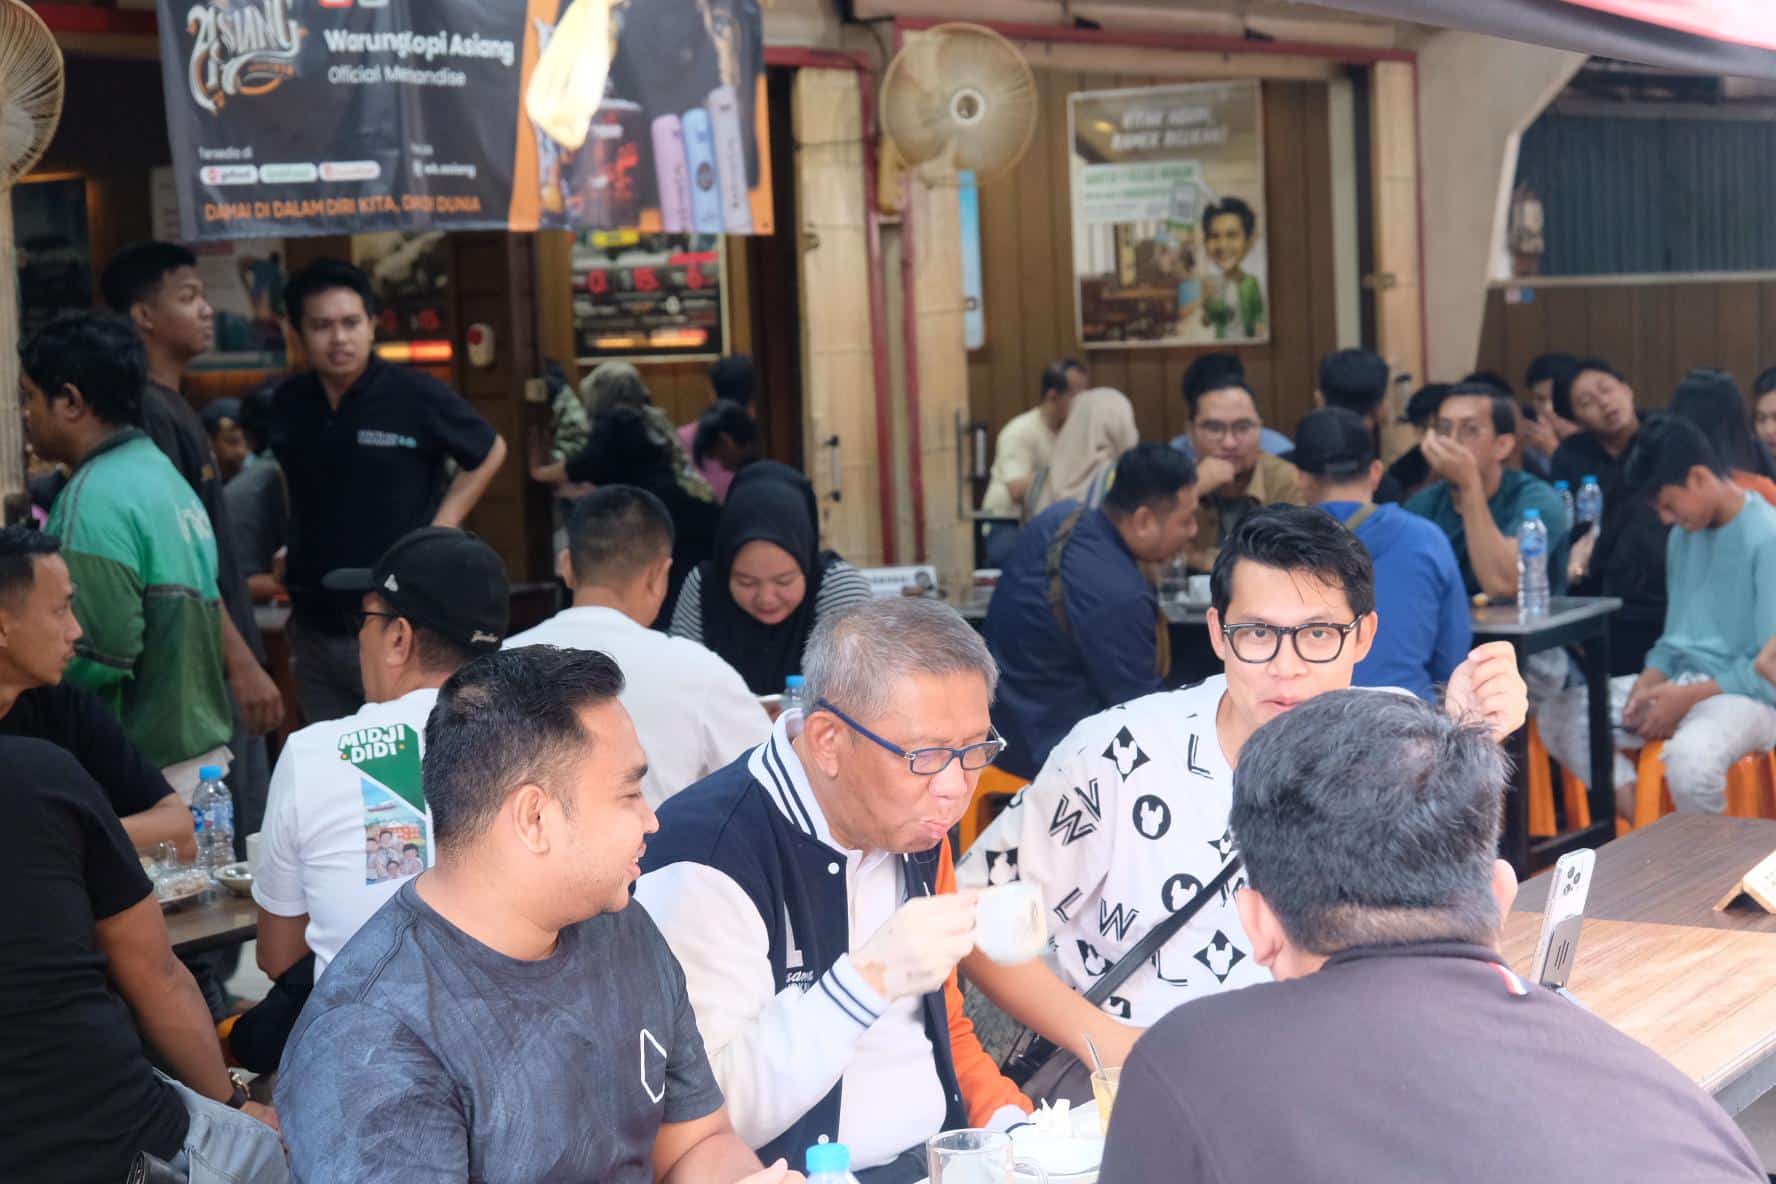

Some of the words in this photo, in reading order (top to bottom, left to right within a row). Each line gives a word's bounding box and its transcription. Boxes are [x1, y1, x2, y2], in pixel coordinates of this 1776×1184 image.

[449, 32, 515, 67] Asiang
[327, 64, 382, 85] Official
[204, 201, 252, 221] DAMAI
[254, 201, 270, 219] DI
[272, 199, 325, 219] DALAM
[338, 723, 406, 750] MIDJI
[351, 742, 398, 764] DIDI
